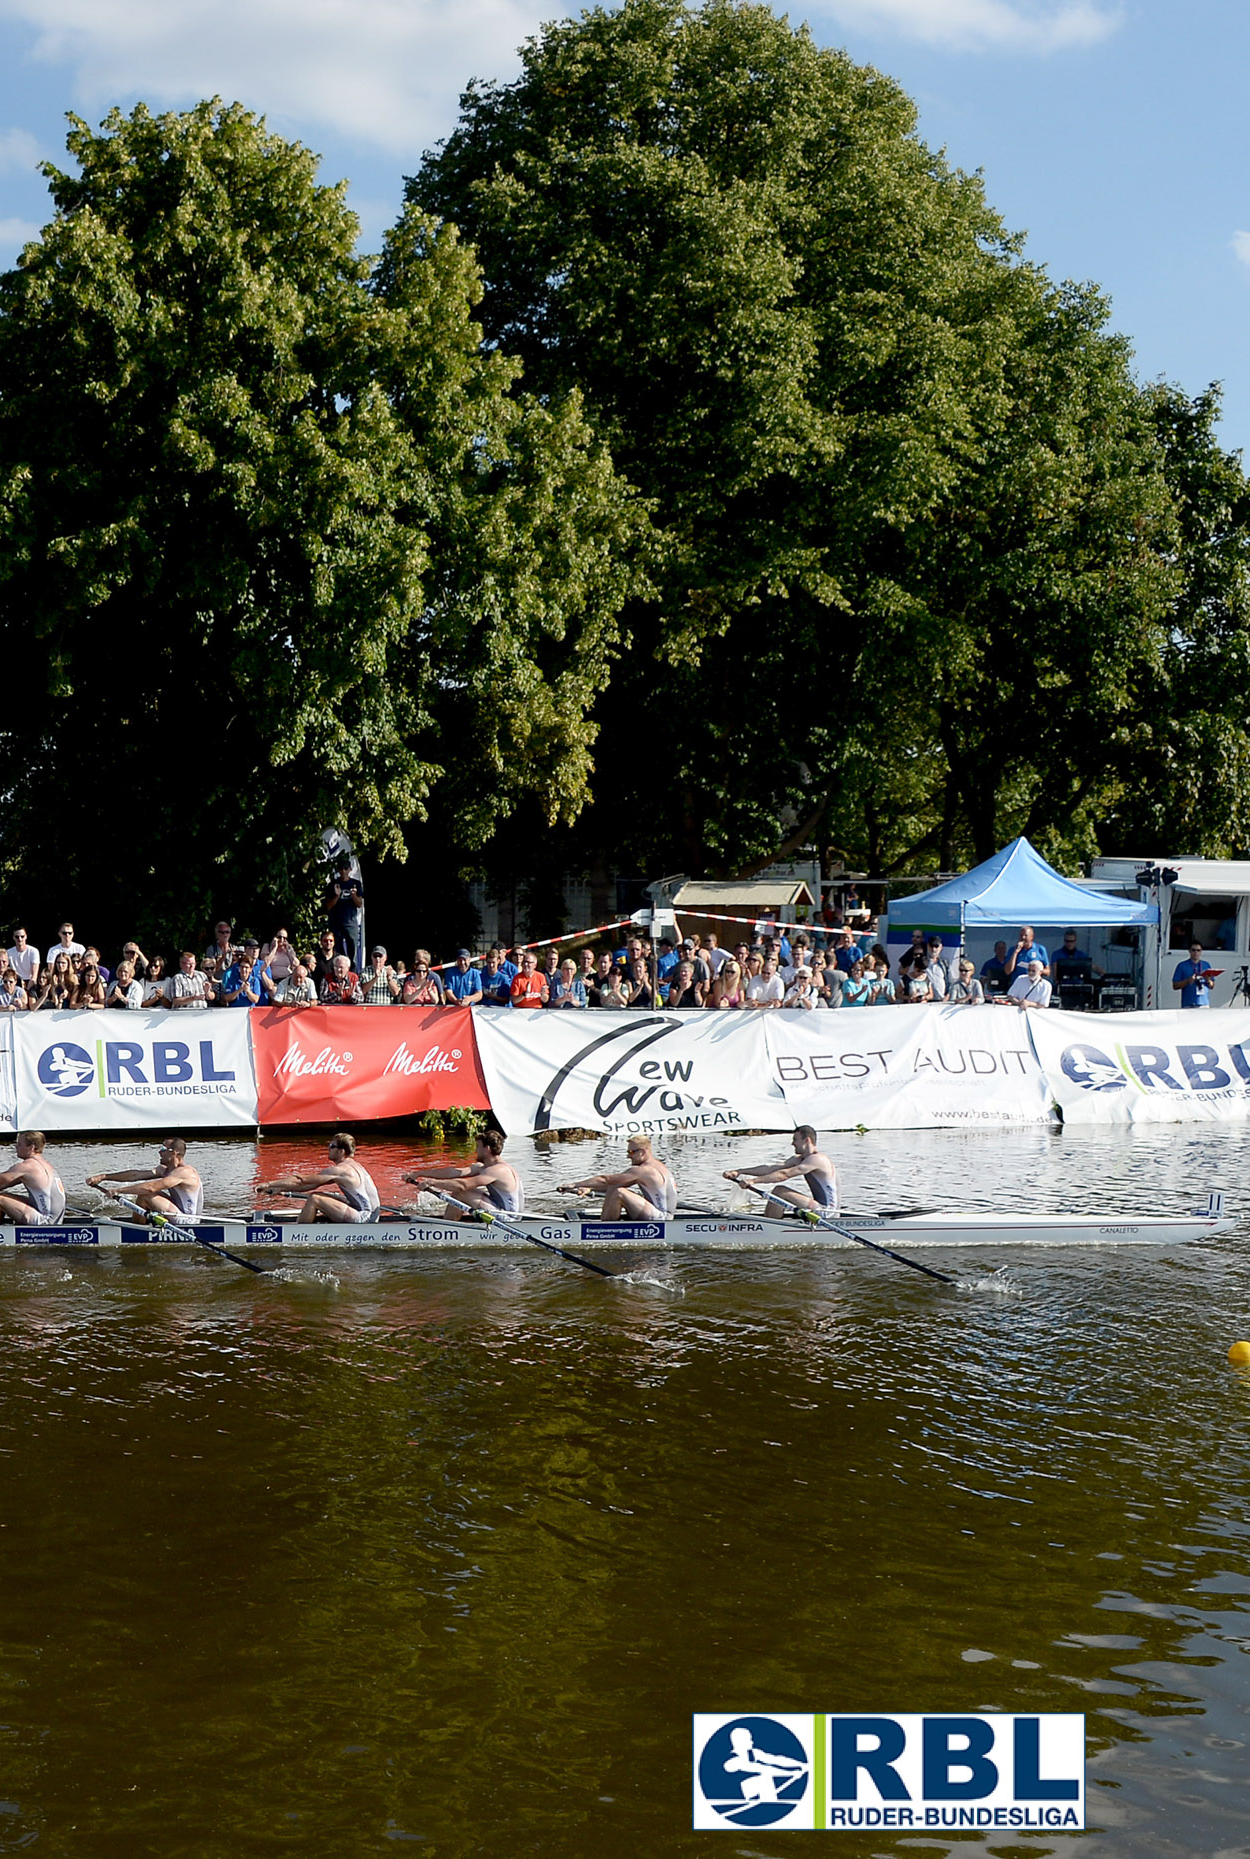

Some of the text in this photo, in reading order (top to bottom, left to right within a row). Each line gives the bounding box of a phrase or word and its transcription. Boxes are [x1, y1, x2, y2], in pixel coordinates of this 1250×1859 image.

[105, 1040, 236, 1083] RBL
[776, 1048, 1029, 1081] BEST AUDIT
[108, 1084, 237, 1096] RUDER-BUNDESLIGA
[603, 1111, 741, 1134] SPORTSWEAR
[931, 1109, 1054, 1124] www.bestaud.de
[291, 1232, 308, 1242] Mit
[315, 1232, 338, 1242] oder
[381, 1231, 401, 1242] den
[408, 1227, 459, 1241] Strom
[480, 1230, 497, 1240] wir
[541, 1226, 571, 1239] Gas
[639, 1228, 655, 1236] EVP
[685, 1223, 764, 1233] SECU INFRA
